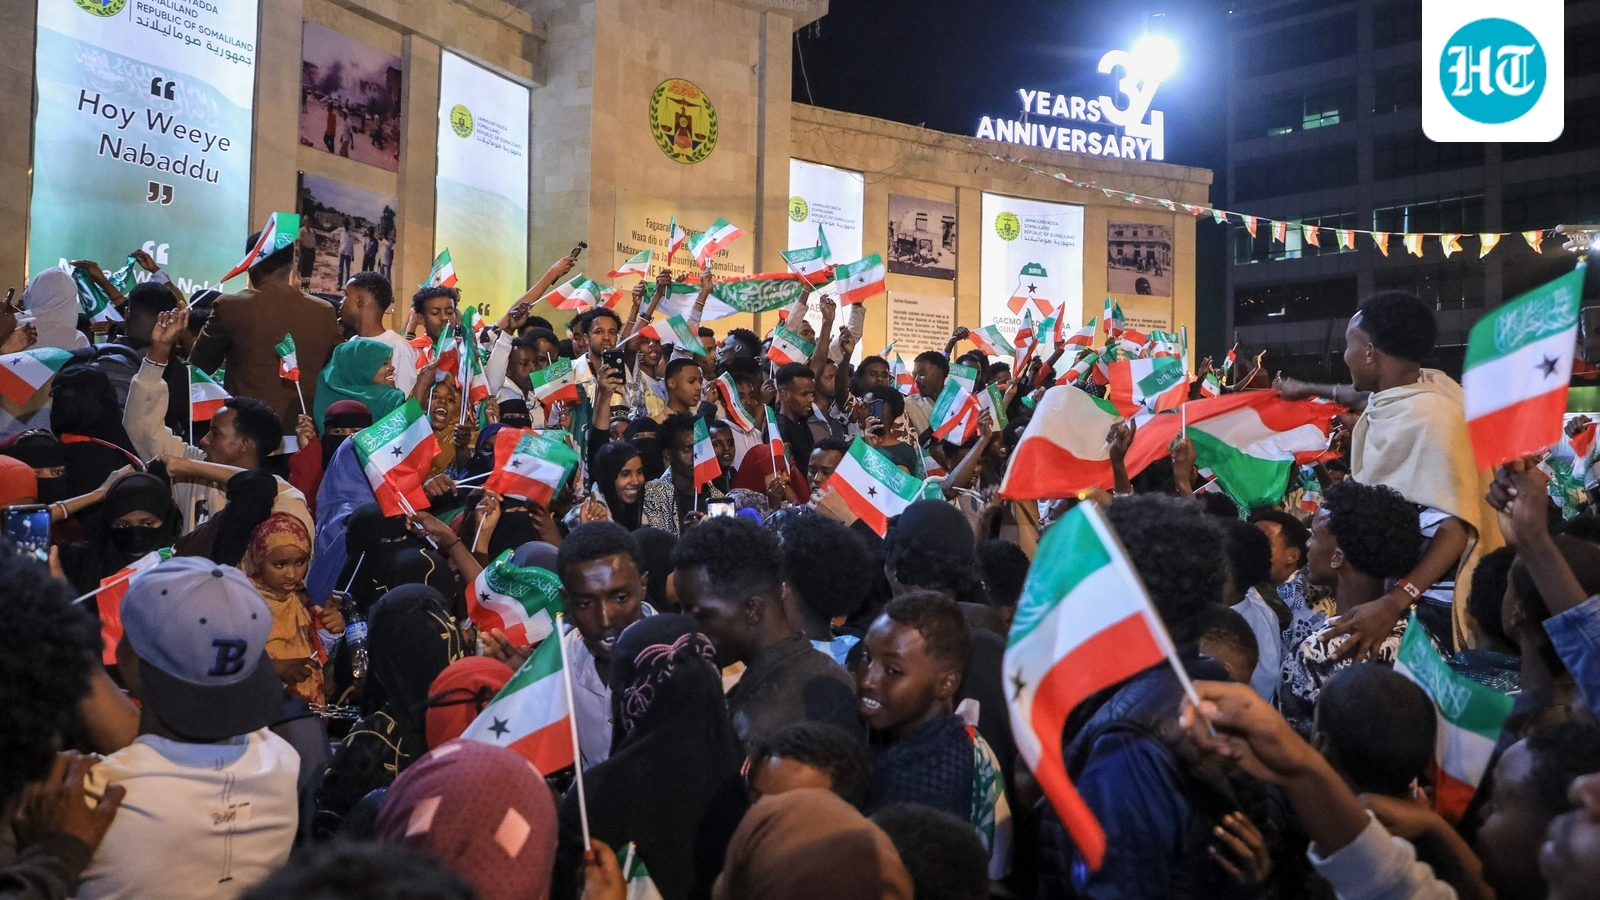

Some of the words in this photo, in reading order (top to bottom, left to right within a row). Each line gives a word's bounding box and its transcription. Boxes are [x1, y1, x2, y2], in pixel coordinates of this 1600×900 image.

[151, 0, 198, 18] ALILAND
[137, 2, 181, 25] REPUBLIC
[183, 20, 196, 30] OF
[198, 25, 253, 52] SOMALILAND
[206, 40, 252, 67] جمهورية
[77, 89, 136, 129] Hoy
[146, 108, 231, 153] Weeye
[1019, 88, 1101, 122] YEARS
[976, 116, 1152, 161] ANNIVERSARY
[98, 133, 219, 184] Nabaddu
[632, 230, 647, 242] Waxa
[648, 234, 657, 244] dib
[659, 238, 663, 246] u
[646, 218, 670, 232] Fagaara
[710, 259, 745, 273] Somaliland
[207, 638, 248, 677] B
